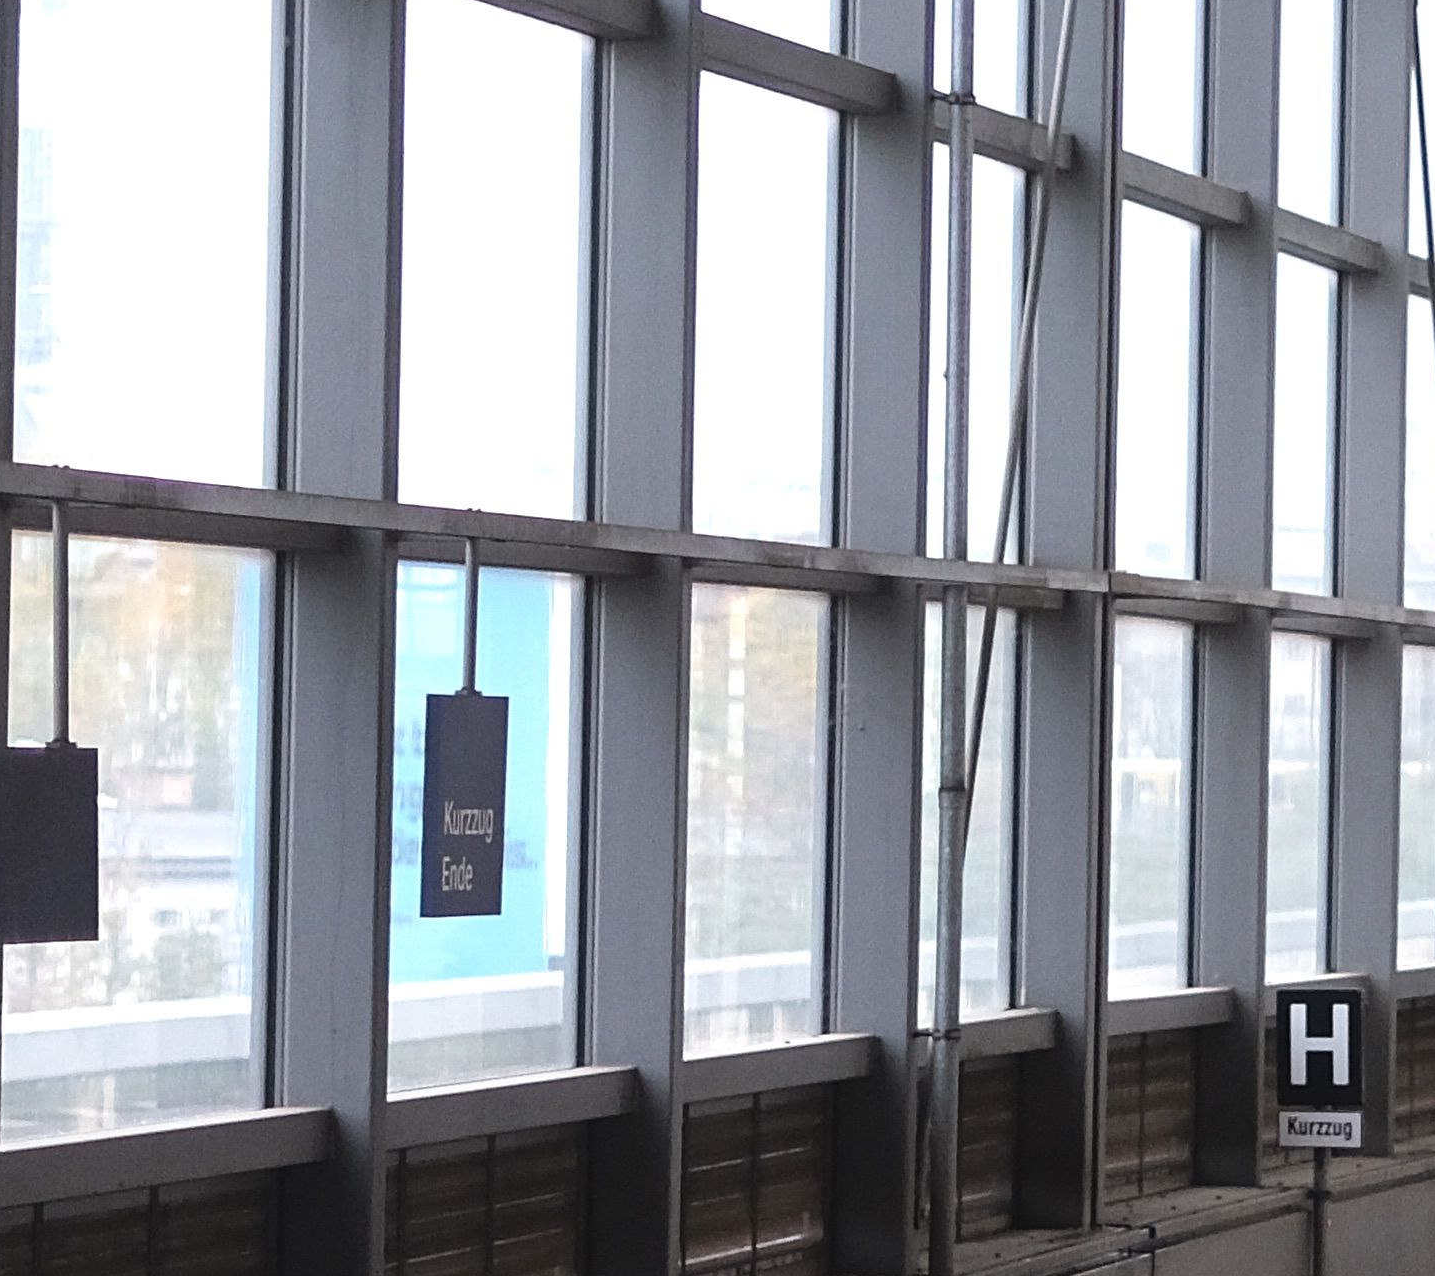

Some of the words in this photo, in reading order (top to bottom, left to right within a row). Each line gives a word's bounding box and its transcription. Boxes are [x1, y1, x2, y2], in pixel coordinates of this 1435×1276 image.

[443, 801, 494, 843] Kurzzug
[441, 856, 474, 892] Ende
[1290, 1003, 1350, 1086] H
[1287, 1116, 1353, 1141] Kurzzug
